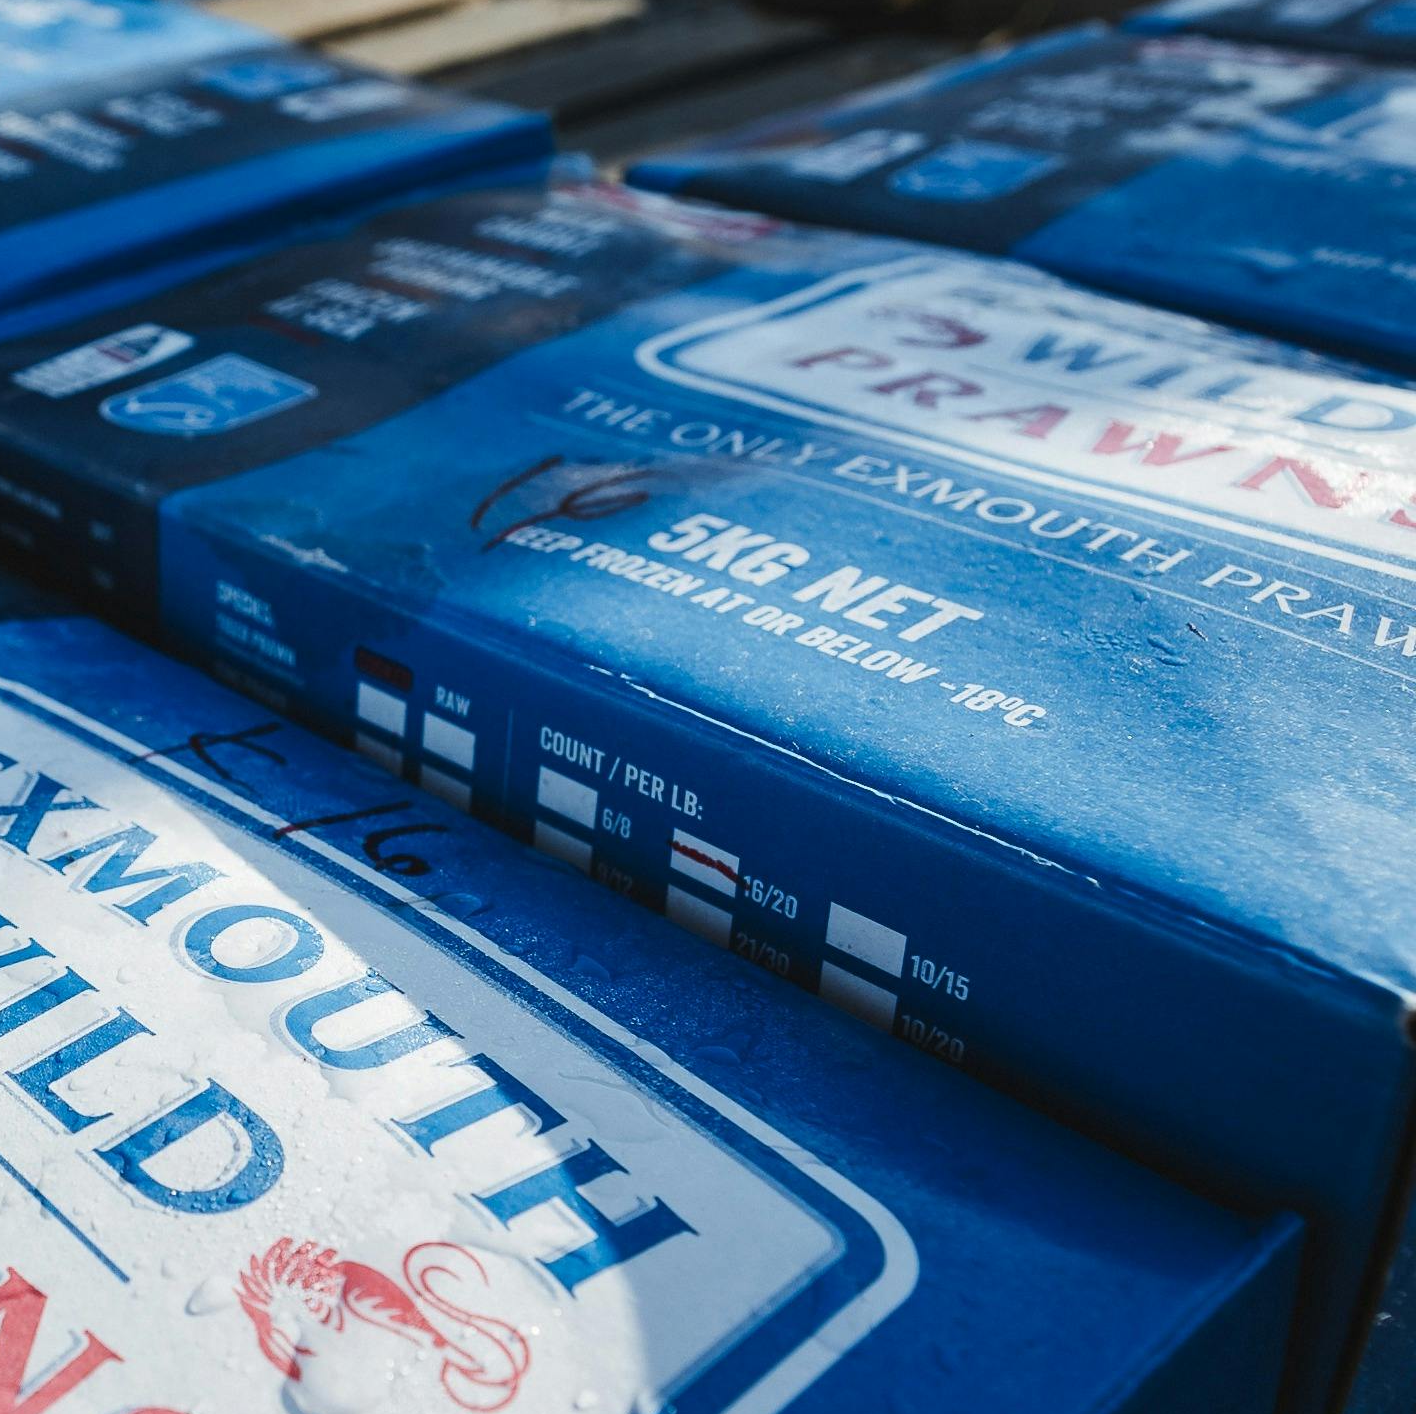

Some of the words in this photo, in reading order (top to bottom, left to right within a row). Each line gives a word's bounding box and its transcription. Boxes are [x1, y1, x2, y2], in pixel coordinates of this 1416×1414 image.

[563, 389, 672, 435] THE
[670, 421, 837, 467] ONLY
[833, 453, 1193, 574] EXMOUTH
[570, 542, 706, 597] FROZEN
[690, 588, 756, 614] AT
[742, 603, 806, 636] OR
[794, 624, 941, 685] BELOW
[647, 513, 811, 587] 5KG
[792, 565, 986, 643] NET
[436, 684, 471, 720] RAW
[539, 725, 607, 776] COUNT
[608, 756, 621, 782] /
[624, 762, 665, 804] PER
[671, 783, 704, 822] LB:
[601, 806, 633, 841] 6/8
[909, 953, 972, 1003] 10/15
[899, 1013, 967, 1064] 10/20
